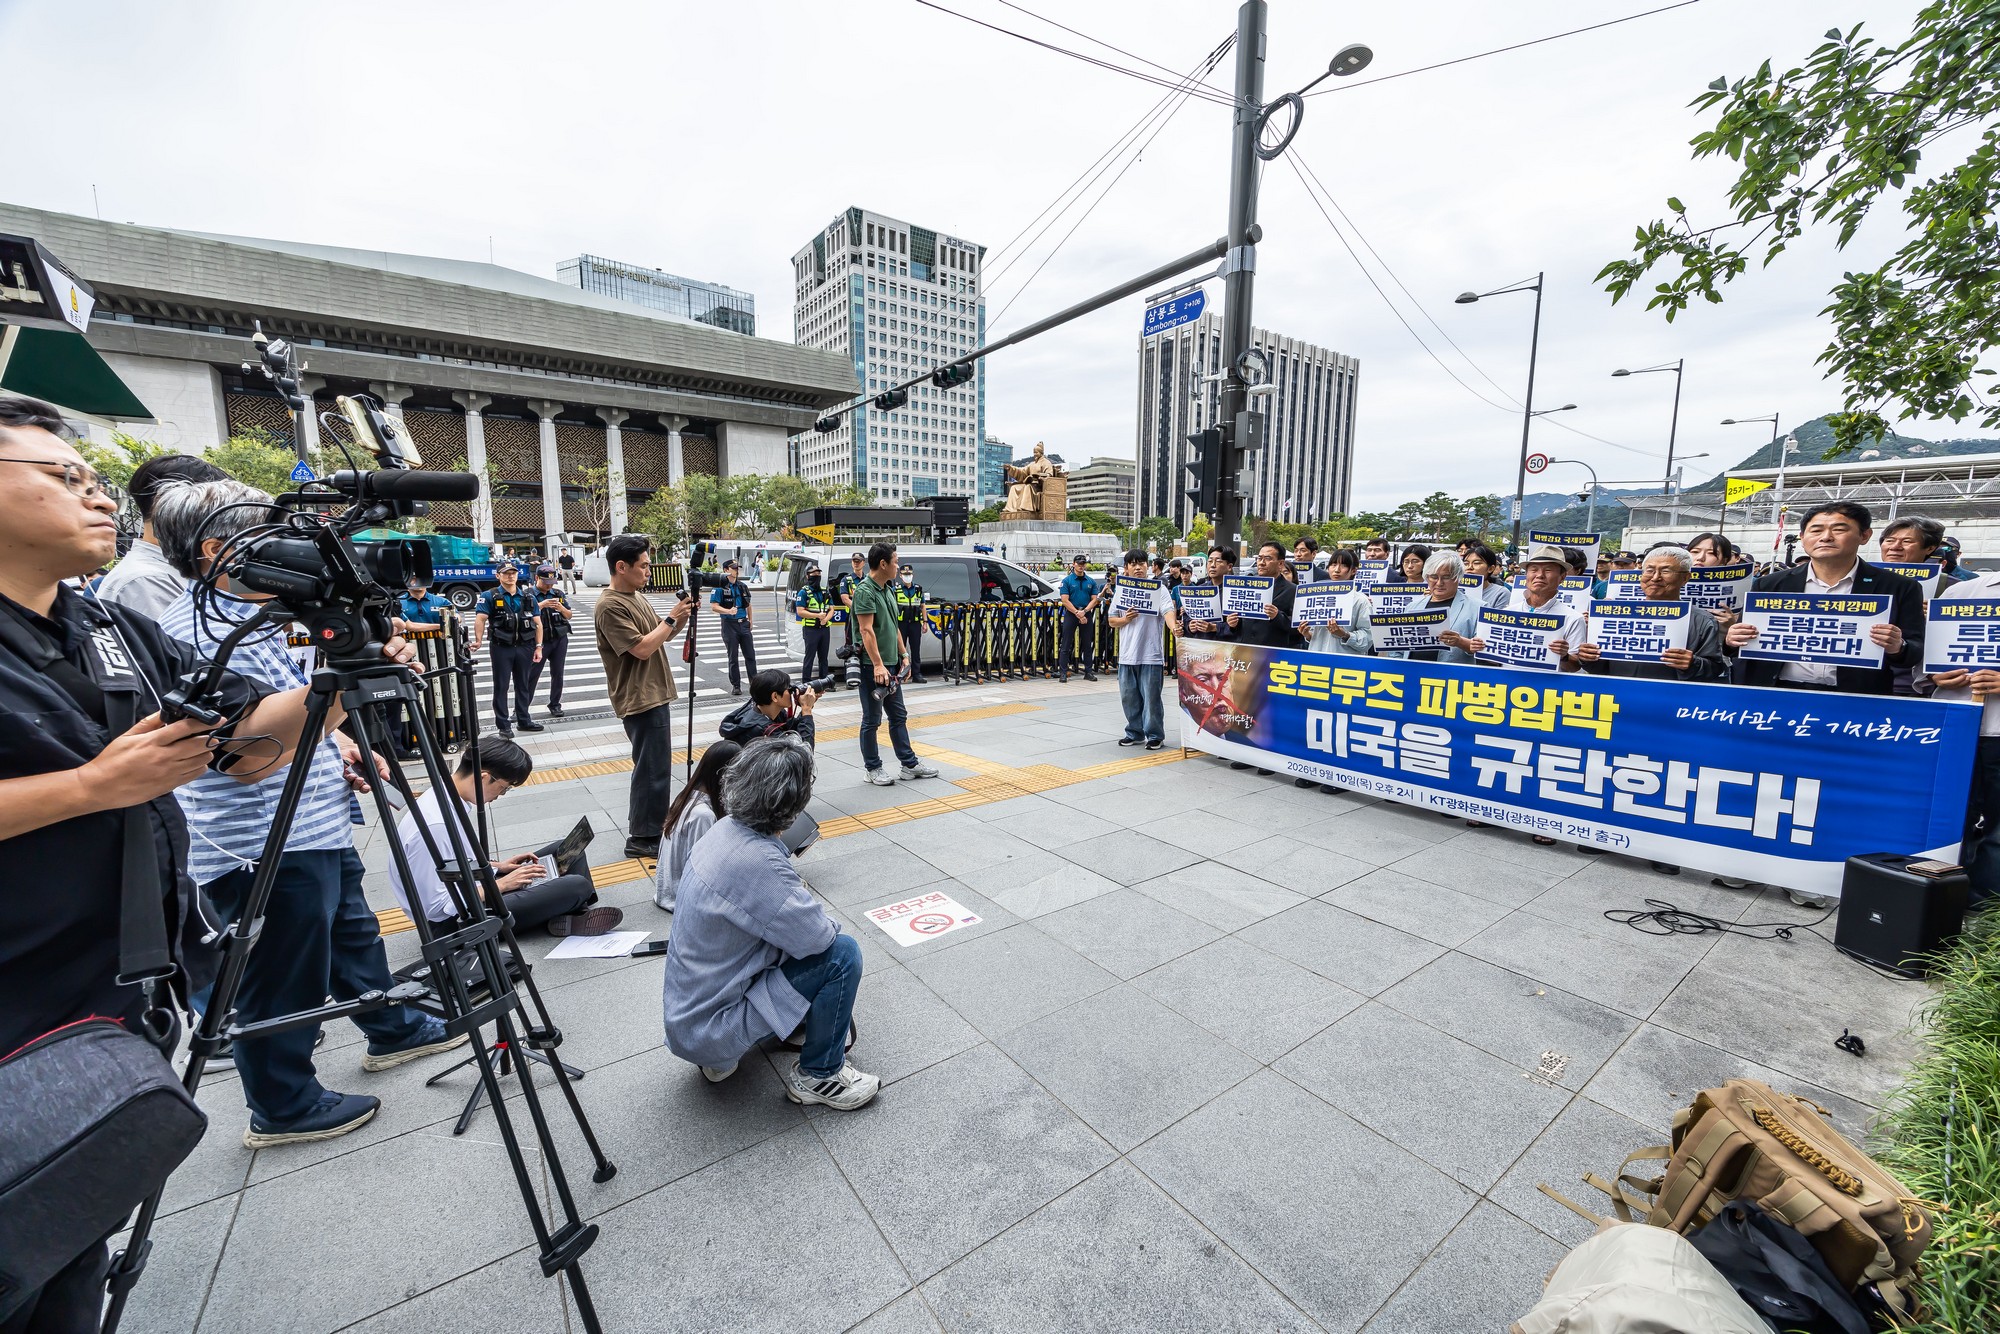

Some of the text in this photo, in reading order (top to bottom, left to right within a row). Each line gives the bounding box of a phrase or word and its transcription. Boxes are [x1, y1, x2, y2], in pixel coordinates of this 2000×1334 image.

[1147, 302, 1177, 324] 삼봉로
[1145, 314, 1188, 335] Sambong-ro
[1529, 458, 1544, 469] 50
[1727, 484, 1755, 496] 25기-1
[1533, 533, 1595, 544] 파병강요 국제깡패
[1703, 568, 1746, 580] 국제깡패
[1883, 567, 1931, 578] 제깡패
[258, 576, 295, 591] SONY
[1121, 587, 1151, 600] 트럼프를
[1229, 588, 1262, 601] 트럼프를
[1119, 598, 1153, 610] 규탄한다!
[1184, 598, 1211, 609] 트럼프를
[1227, 600, 1264, 613] 규탄한다!
[1306, 596, 1337, 608] 미국을
[1754, 598, 1878, 613] 파병강요 국제깡패
[1298, 607, 1343, 621] 규탄한다!
[1595, 605, 1681, 617] 파병강요 국제깡패
[1483, 611, 1558, 629] 파병강요 국제깡패
[1767, 615, 1858, 636] 트럼프를
[1390, 626, 1430, 637] 미국을
[1489, 626, 1545, 645] 트럼프를
[1602, 620, 1667, 636] 트럼프를
[1383, 635, 1441, 647] 규탄한다!
[1597, 635, 1671, 654] 규탄한다!
[1758, 635, 1863, 656] 규탄한다!
[1485, 639, 1548, 662] 규탄한다!
[1266, 659, 1620, 740] 호르무즈 파병압박
[1676, 706, 1941, 744] 미대사관 앞 기자회견
[1305, 708, 1822, 846] 미국을 규탄한다!
[1287, 761, 1631, 848] 2026년 9월 10일(목) 오후 2시 KT광화문빌딩(광화문역 2번 출구)
[871, 893, 947, 920] 금연구역
